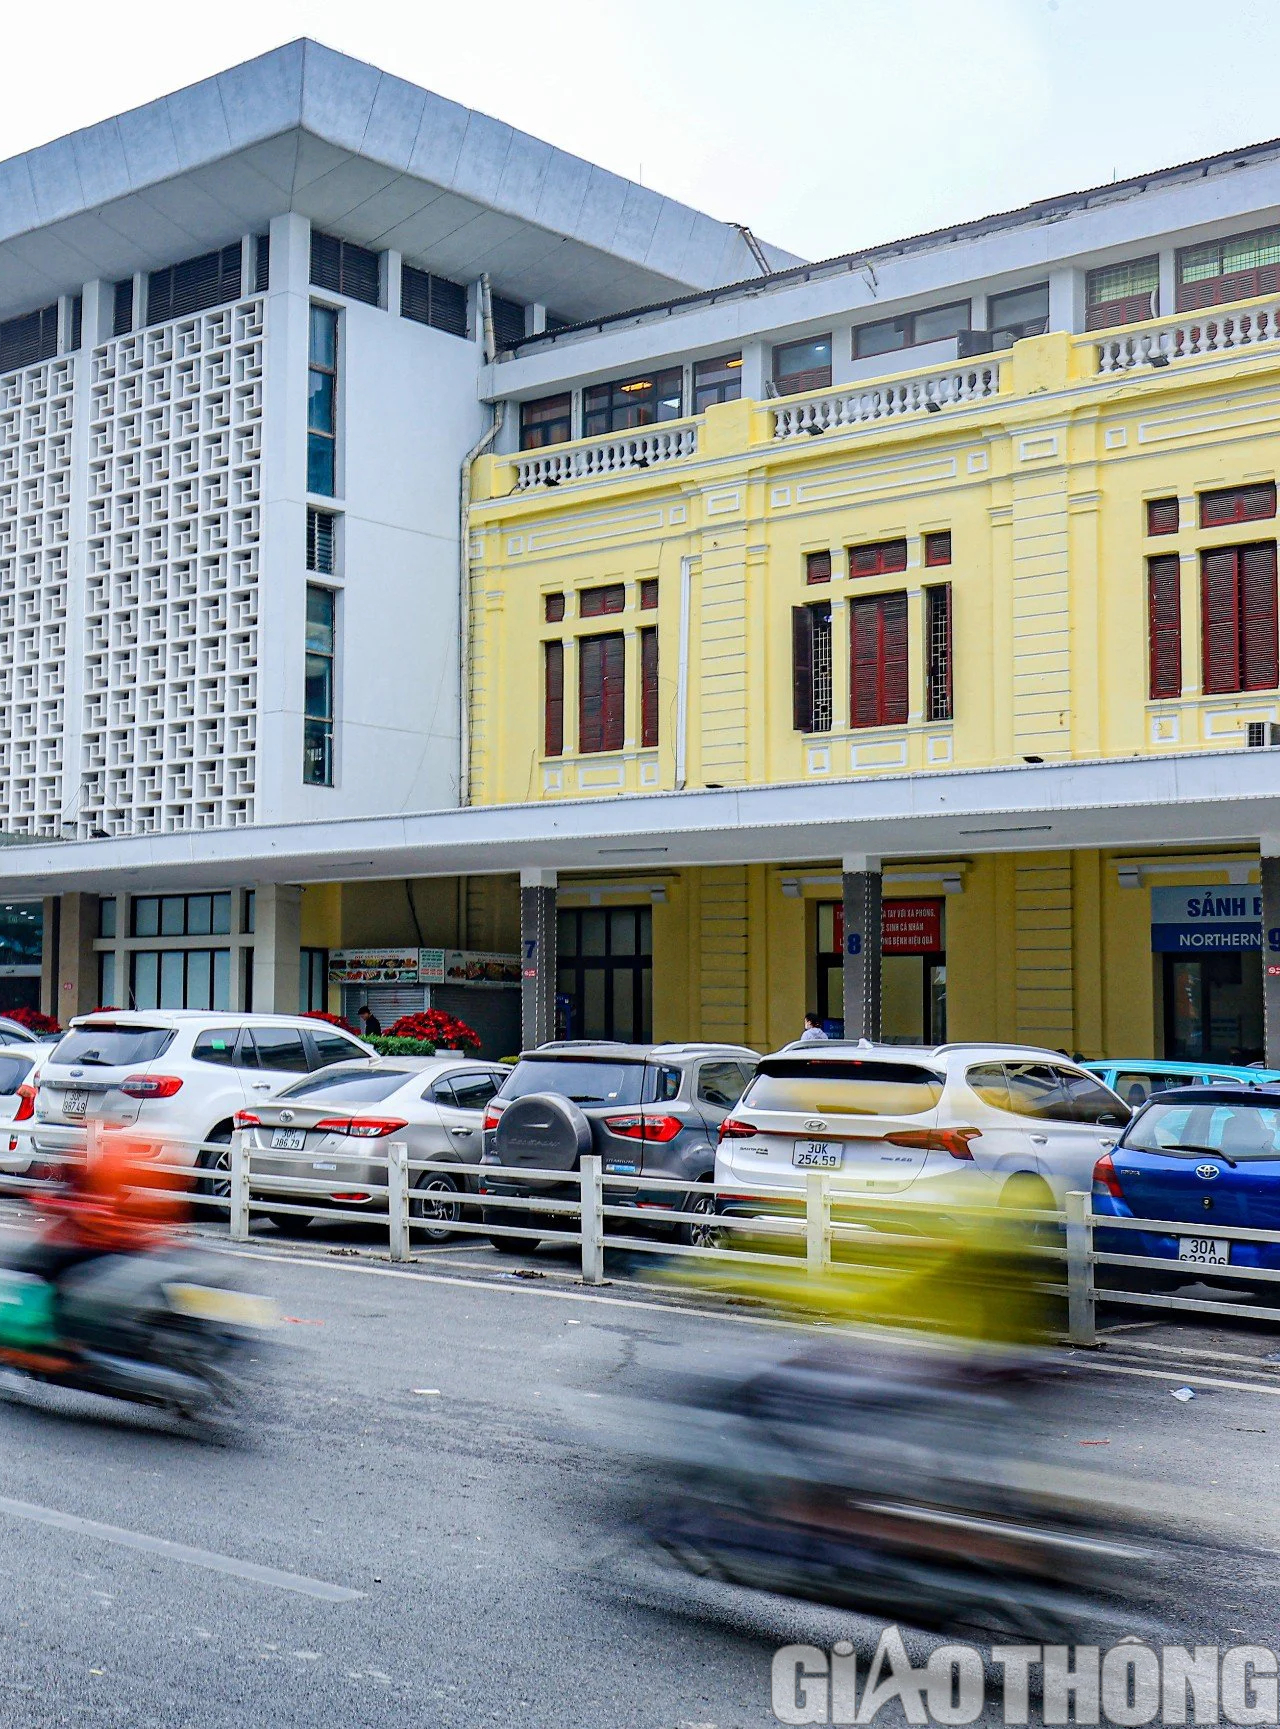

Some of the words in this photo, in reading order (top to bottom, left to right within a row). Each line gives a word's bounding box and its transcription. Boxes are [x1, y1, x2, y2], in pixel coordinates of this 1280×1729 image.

[1187, 891, 1245, 917] SẢNH
[847, 933, 861, 955] 8
[1179, 934, 1261, 946] NORTHERN
[524, 940, 537, 958] 7
[808, 1143, 828, 1154] 30K
[797, 1154, 836, 1166] 254.59
[1190, 1240, 1216, 1255] 30A
